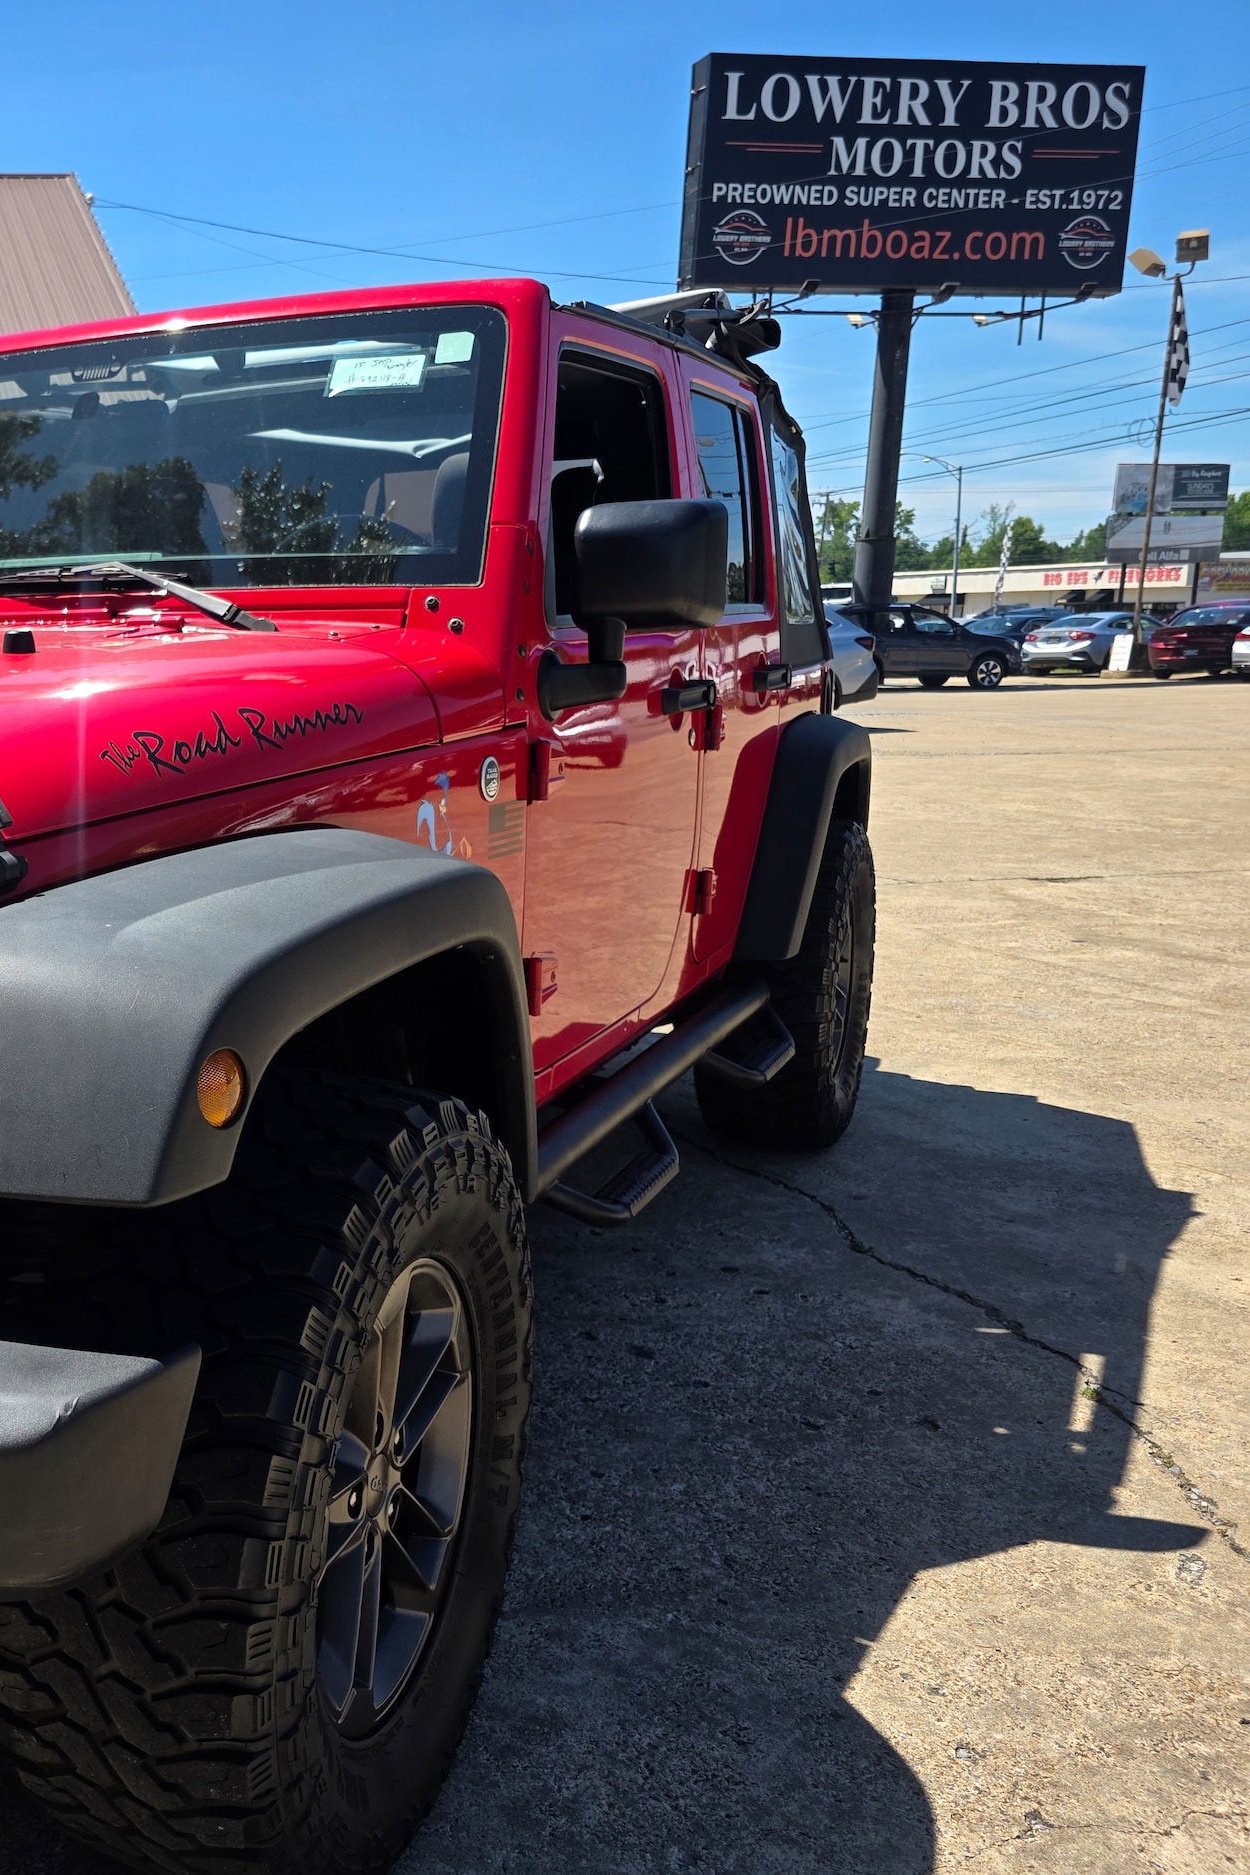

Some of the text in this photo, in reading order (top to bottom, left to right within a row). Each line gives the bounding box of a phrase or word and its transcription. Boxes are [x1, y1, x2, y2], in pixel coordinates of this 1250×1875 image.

[720, 71, 1132, 131] LOWERY BROS
[826, 136, 1024, 180] MOTORS
[711, 182, 839, 207] PREOWNED
[844, 186, 918, 209] SUPER
[922, 187, 1006, 210] CENTER
[1024, 188, 1123, 211] EST.1972
[782, 216, 1045, 261] lbmboaz.com
[1043, 572, 1062, 586] BIG
[1107, 567, 1181, 583] FIEORKS
[100, 702, 364, 778] The Road Runner
[468, 1221, 518, 1421] CENTENNIAL
